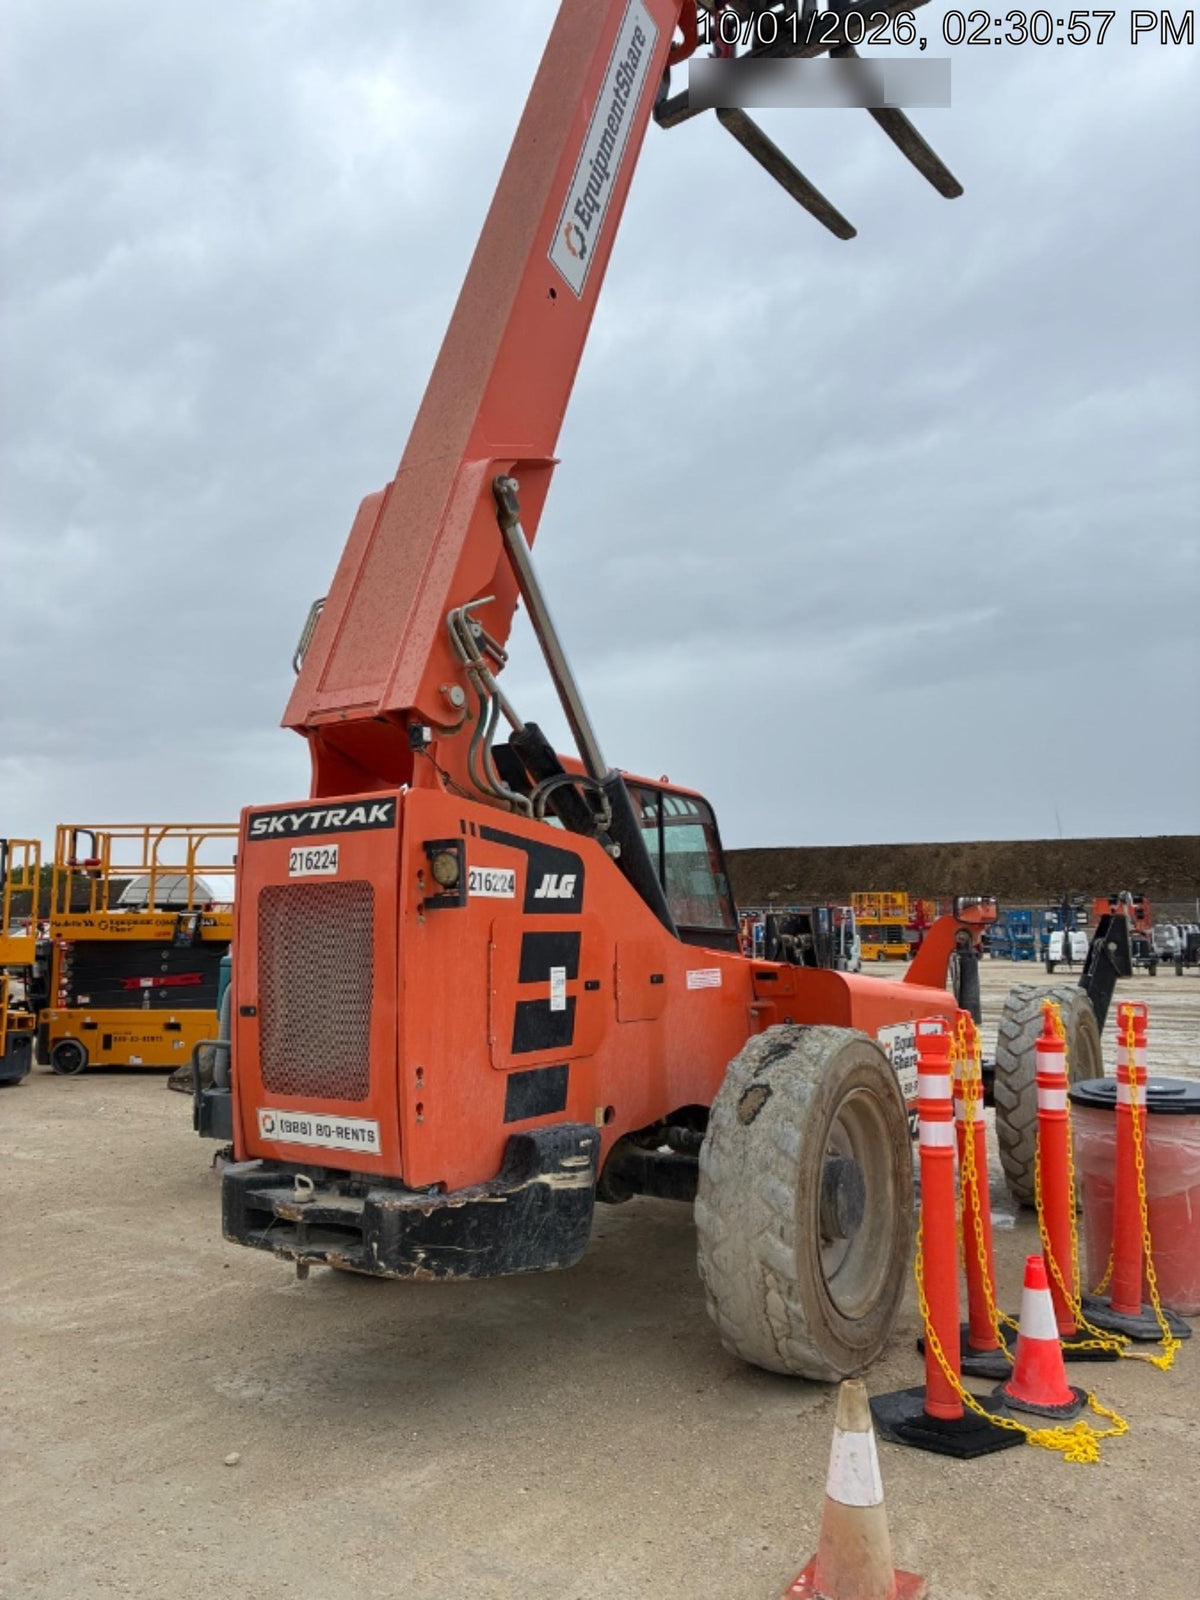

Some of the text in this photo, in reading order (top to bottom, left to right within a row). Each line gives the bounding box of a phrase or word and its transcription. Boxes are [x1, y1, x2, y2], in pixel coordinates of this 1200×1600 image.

[574, 25, 647, 231] EquipmentShare
[250, 803, 393, 835] SKYTRAK
[289, 849, 337, 872] 216224
[469, 871, 515, 893] 216224
[534, 874, 577, 899] JLG
[316, 1124, 376, 1143] 80-RENTS
